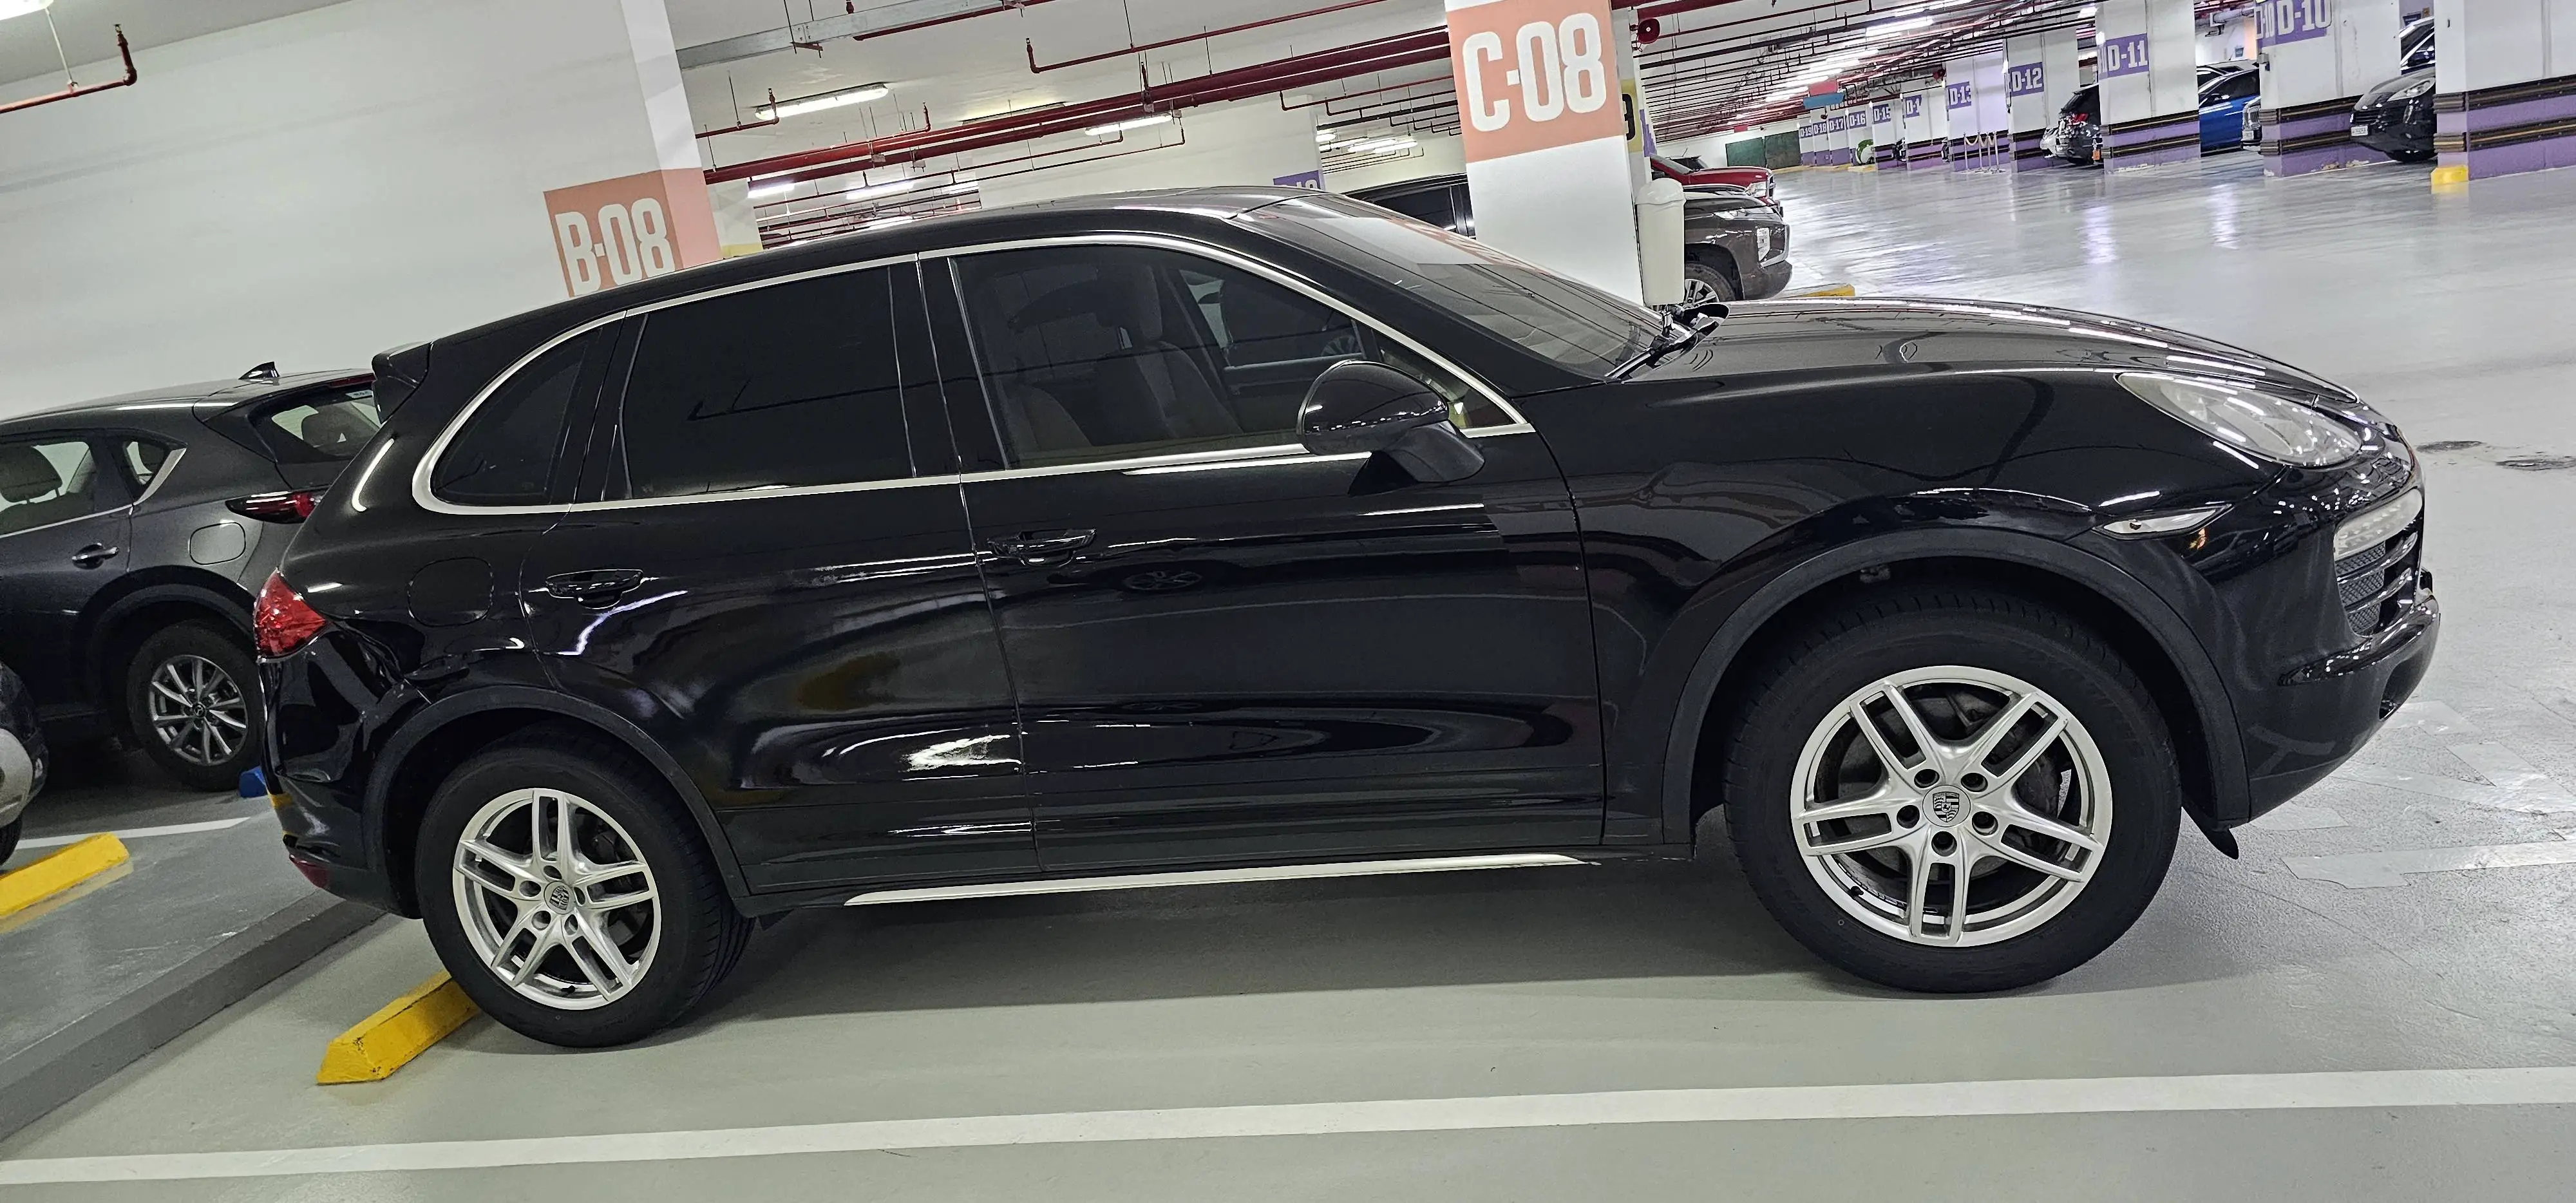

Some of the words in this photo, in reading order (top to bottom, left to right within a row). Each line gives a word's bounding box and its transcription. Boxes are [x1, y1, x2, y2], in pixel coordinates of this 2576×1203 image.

[2277, 0, 2331, 35] D-10
[2107, 40, 2148, 71] D-11
[1463, 13, 1607, 131] C-08
[2011, 68, 2043, 91] D-12
[1949, 86, 1971, 105] D-13
[1850, 113, 1866, 127] D-16
[1874, 106, 1891, 122] D-15
[1801, 128, 1813, 137] D-19
[1814, 123, 1827, 135] D-18
[1830, 118, 1844, 131] D-17
[555, 198, 675, 296] B-08
